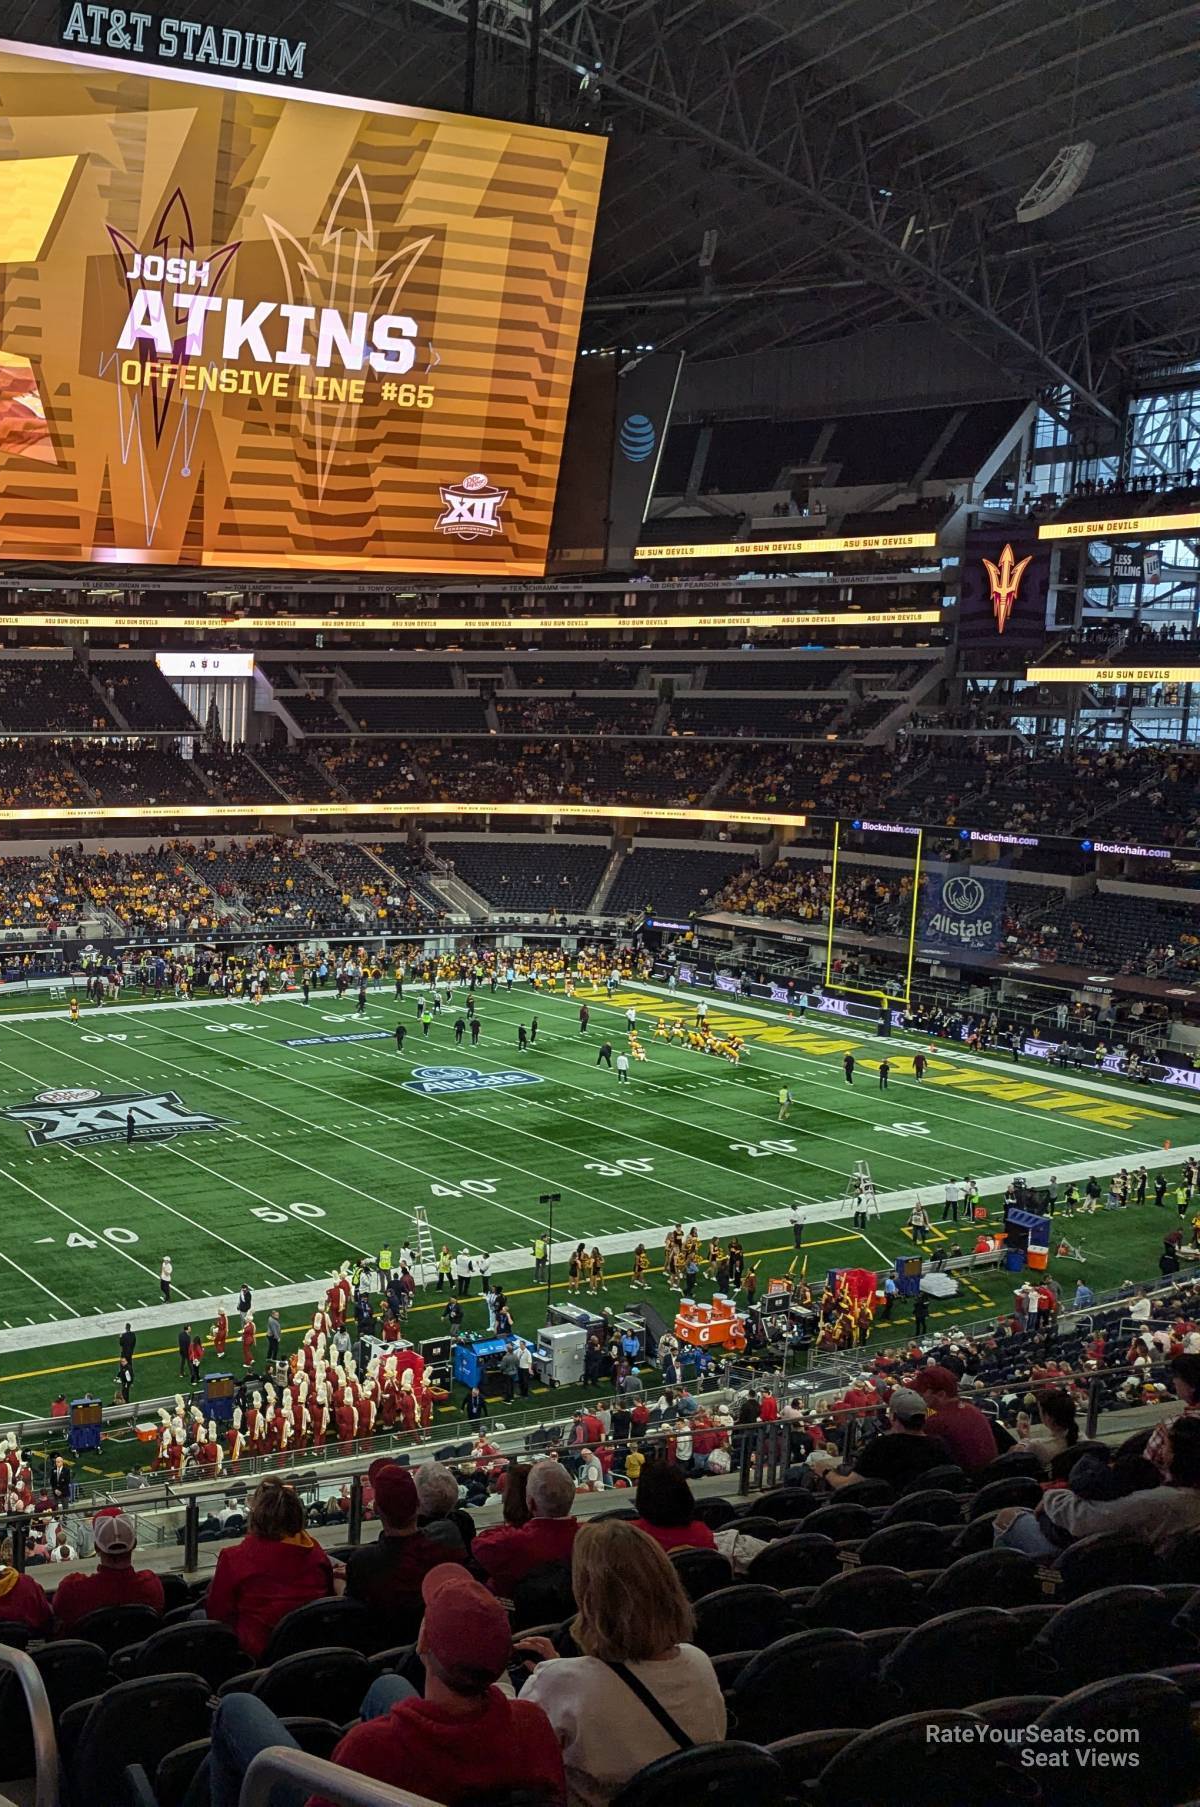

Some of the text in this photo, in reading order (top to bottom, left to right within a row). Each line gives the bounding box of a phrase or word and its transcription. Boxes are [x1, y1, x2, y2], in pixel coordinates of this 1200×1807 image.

[63, 2, 307, 78] AT&T STADIUM
[126, 253, 210, 287] JOSH
[116, 288, 418, 375] ATKINS
[121, 359, 435, 409] OFFENSIVE LINE #65
[1067, 522, 1139, 534] ASU SUN DEVILS
[734, 543, 802, 553] ASU SUN DEVILS
[843, 537, 913, 548] ASU SUN DEVILS
[1114, 554, 1132, 565] LESS
[1113, 565, 1141, 577] FILLING
[1096, 670, 1170, 679] ASU SUN DEVILS
[862, 821, 922, 835] Blockchain.com
[970, 831, 1039, 846] Blockchain.com
[1093, 842, 1171, 859] Blockchain.com
[929, 912, 992, 937] Allstate
[423, 1074, 527, 1093] Allstate
[249, 1202, 326, 1224] 50
[65, 1227, 140, 1250] 40
[699, 1327, 710, 1342] G
